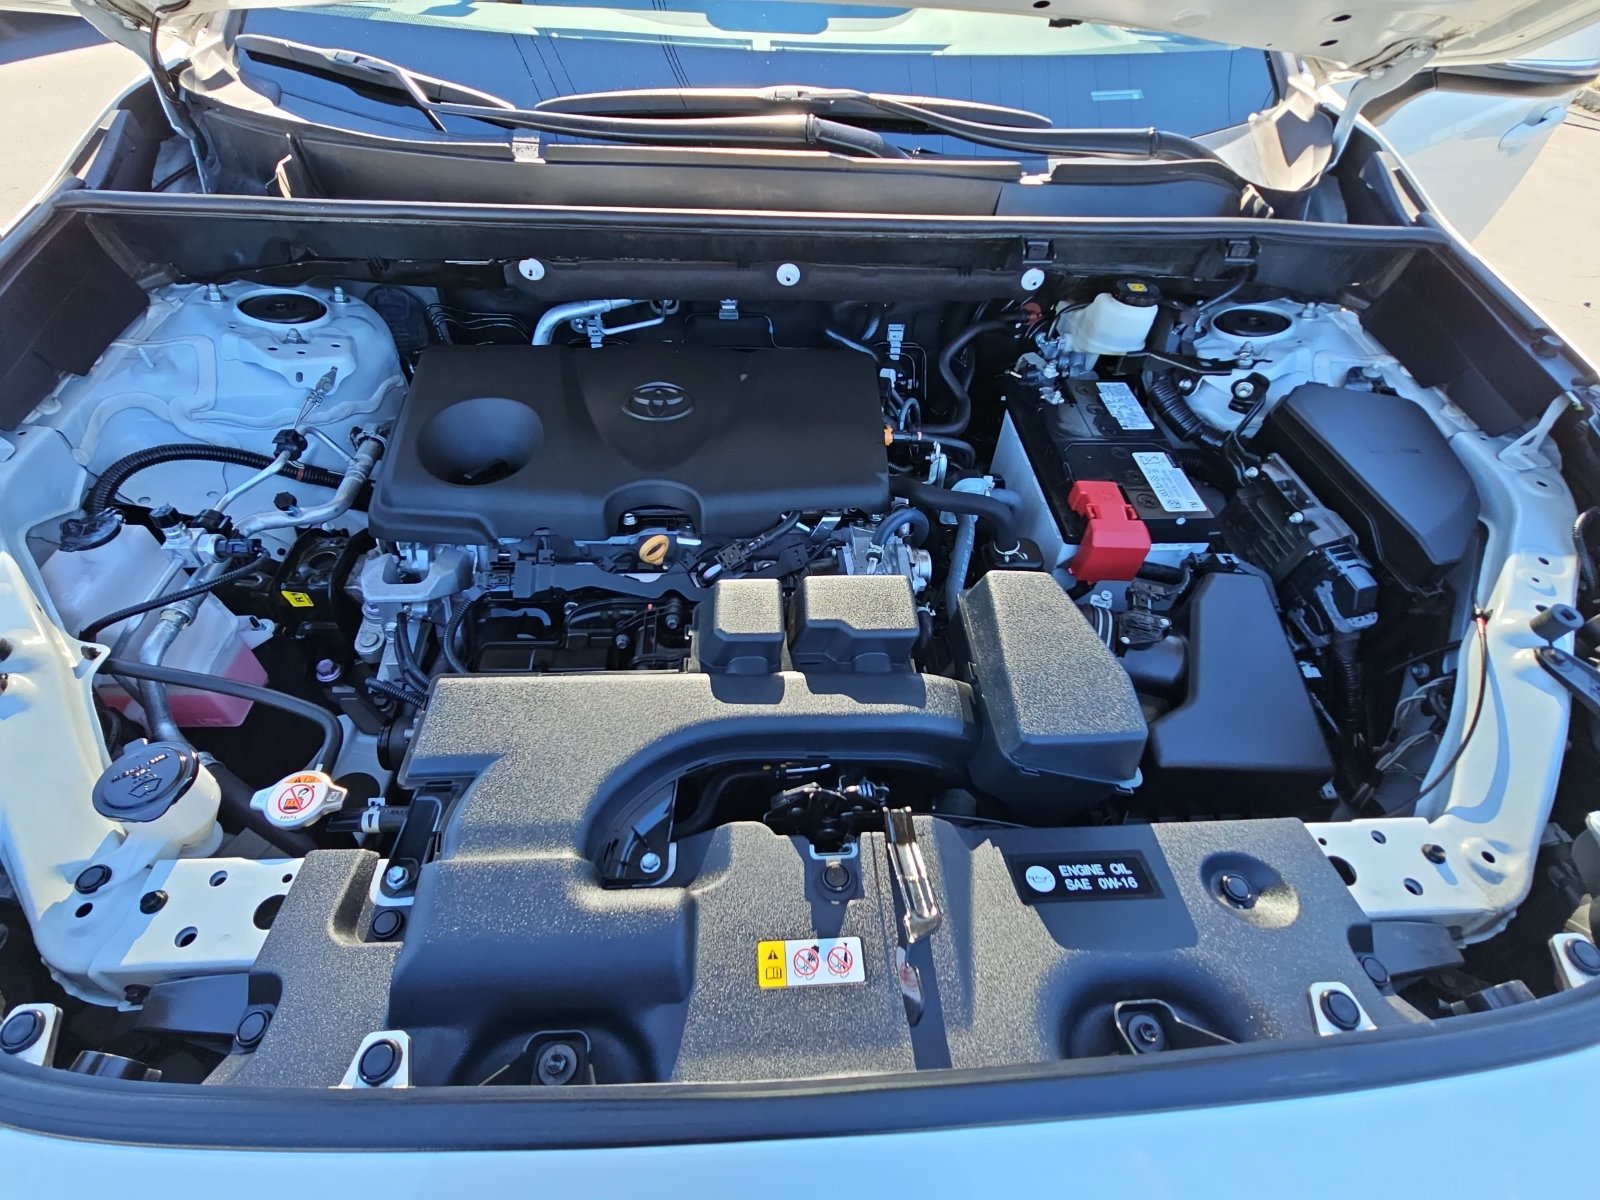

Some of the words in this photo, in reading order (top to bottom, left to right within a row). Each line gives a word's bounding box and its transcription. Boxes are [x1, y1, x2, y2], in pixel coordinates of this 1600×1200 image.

[1058, 864, 1105, 876] ENGINE
[1109, 863, 1133, 875] OIL
[1064, 878, 1092, 890] SAE
[1097, 876, 1138, 889] 0W-16
